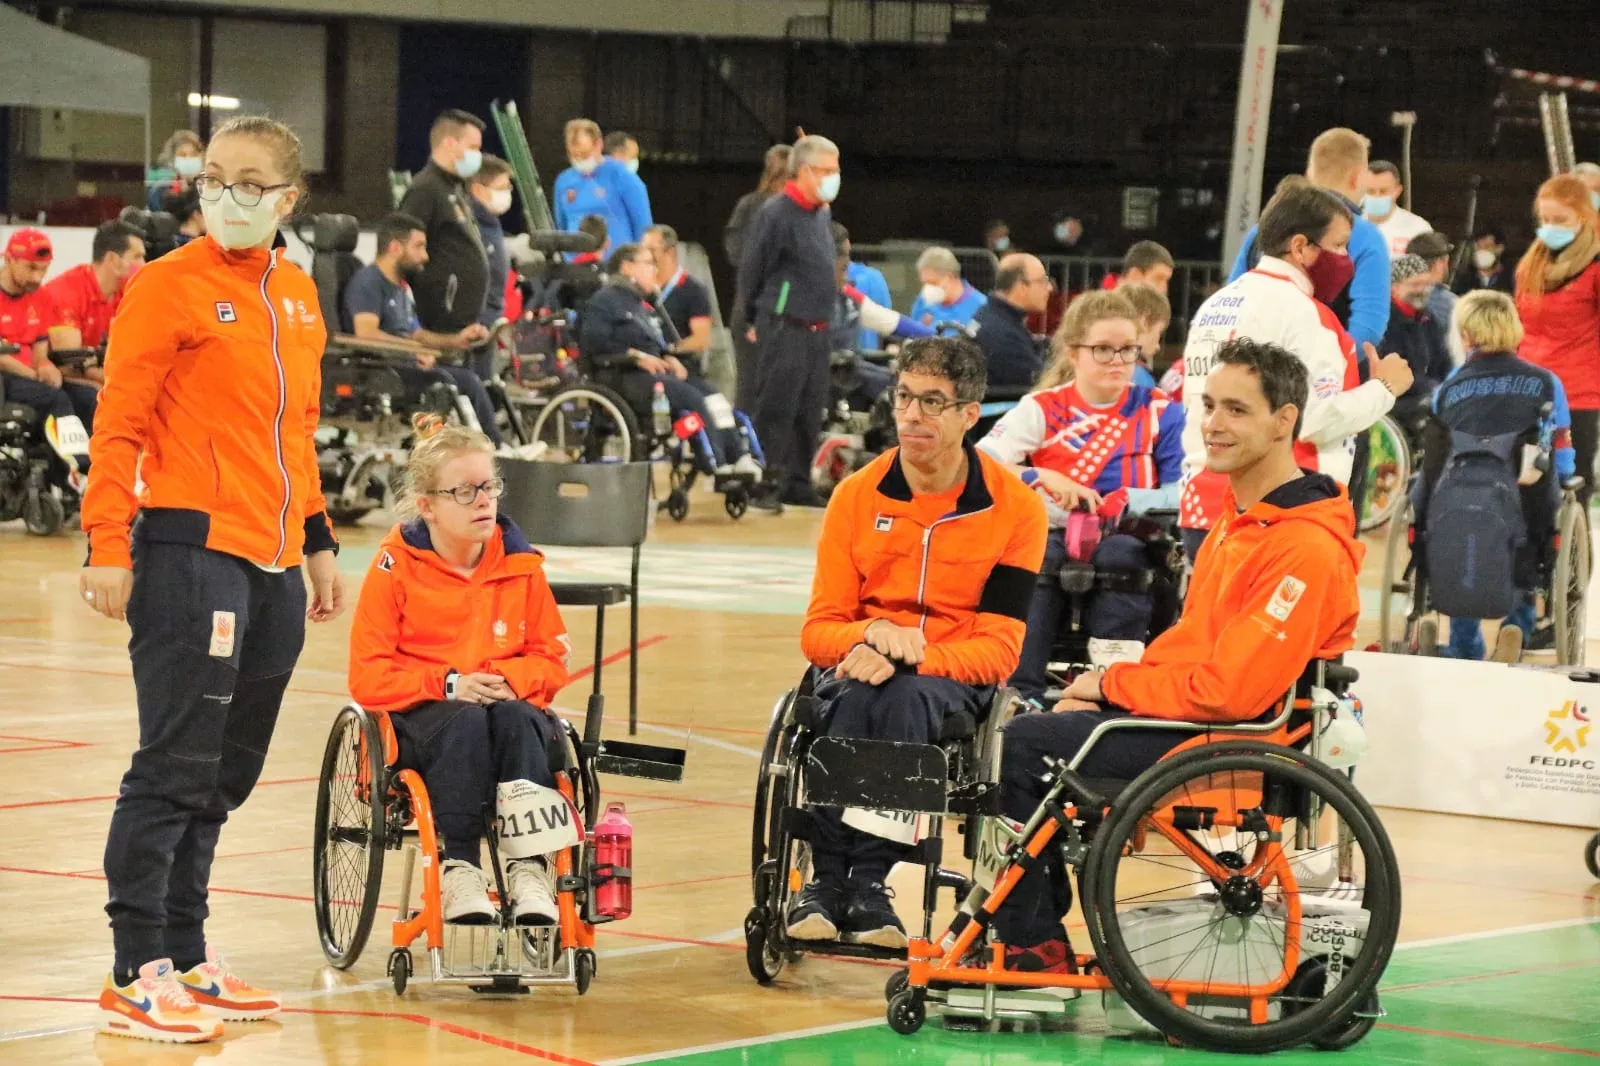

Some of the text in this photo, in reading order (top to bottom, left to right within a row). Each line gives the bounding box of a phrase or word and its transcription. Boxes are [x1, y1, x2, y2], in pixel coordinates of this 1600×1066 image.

[1199, 312, 1238, 328] Britain
[1530, 755, 1595, 770] FEDPC
[498, 802, 569, 839] 211W
